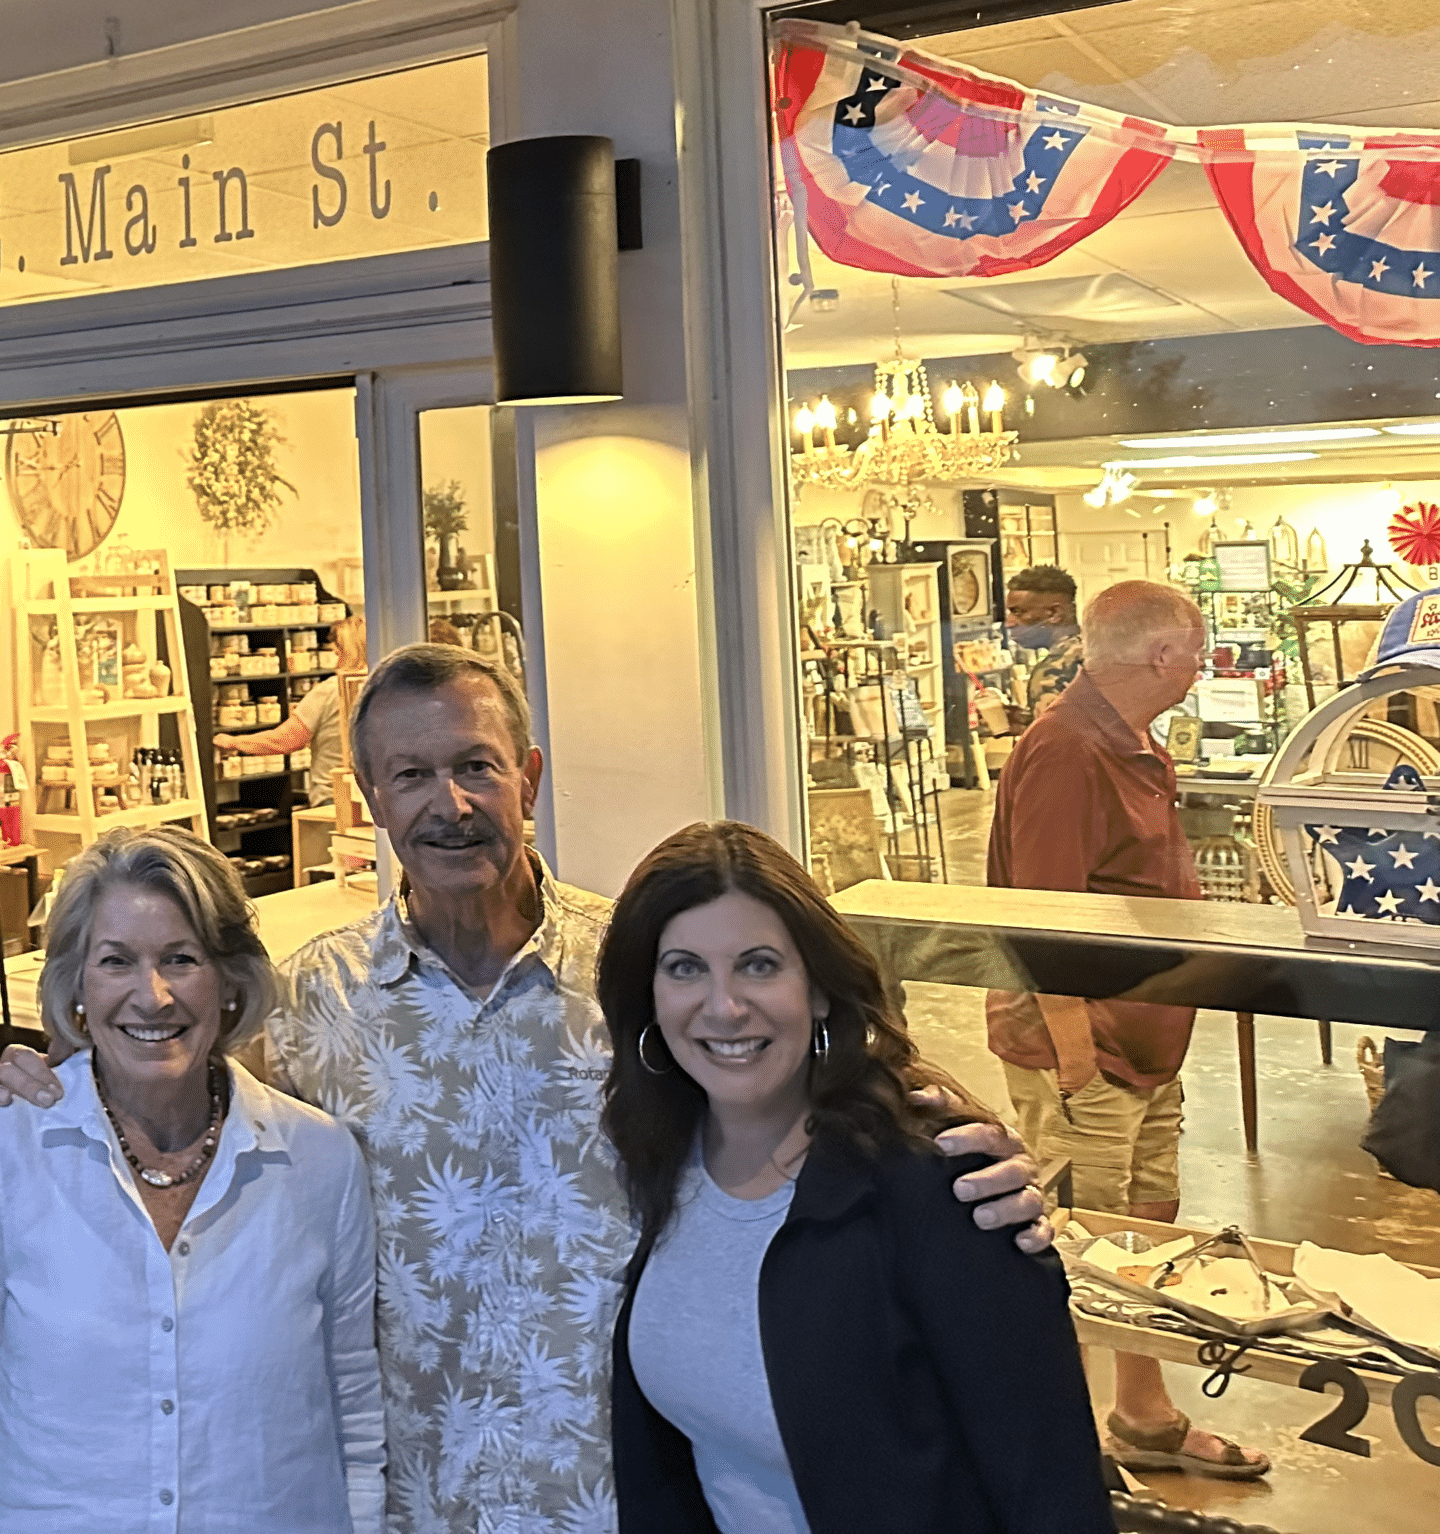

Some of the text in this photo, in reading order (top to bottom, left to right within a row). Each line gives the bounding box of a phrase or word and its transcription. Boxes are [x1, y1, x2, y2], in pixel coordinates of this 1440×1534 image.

[58, 152, 256, 267] Main
[311, 120, 442, 230] St.
[568, 1066, 610, 1081] Rotar
[1197, 1336, 1258, 1398] of
